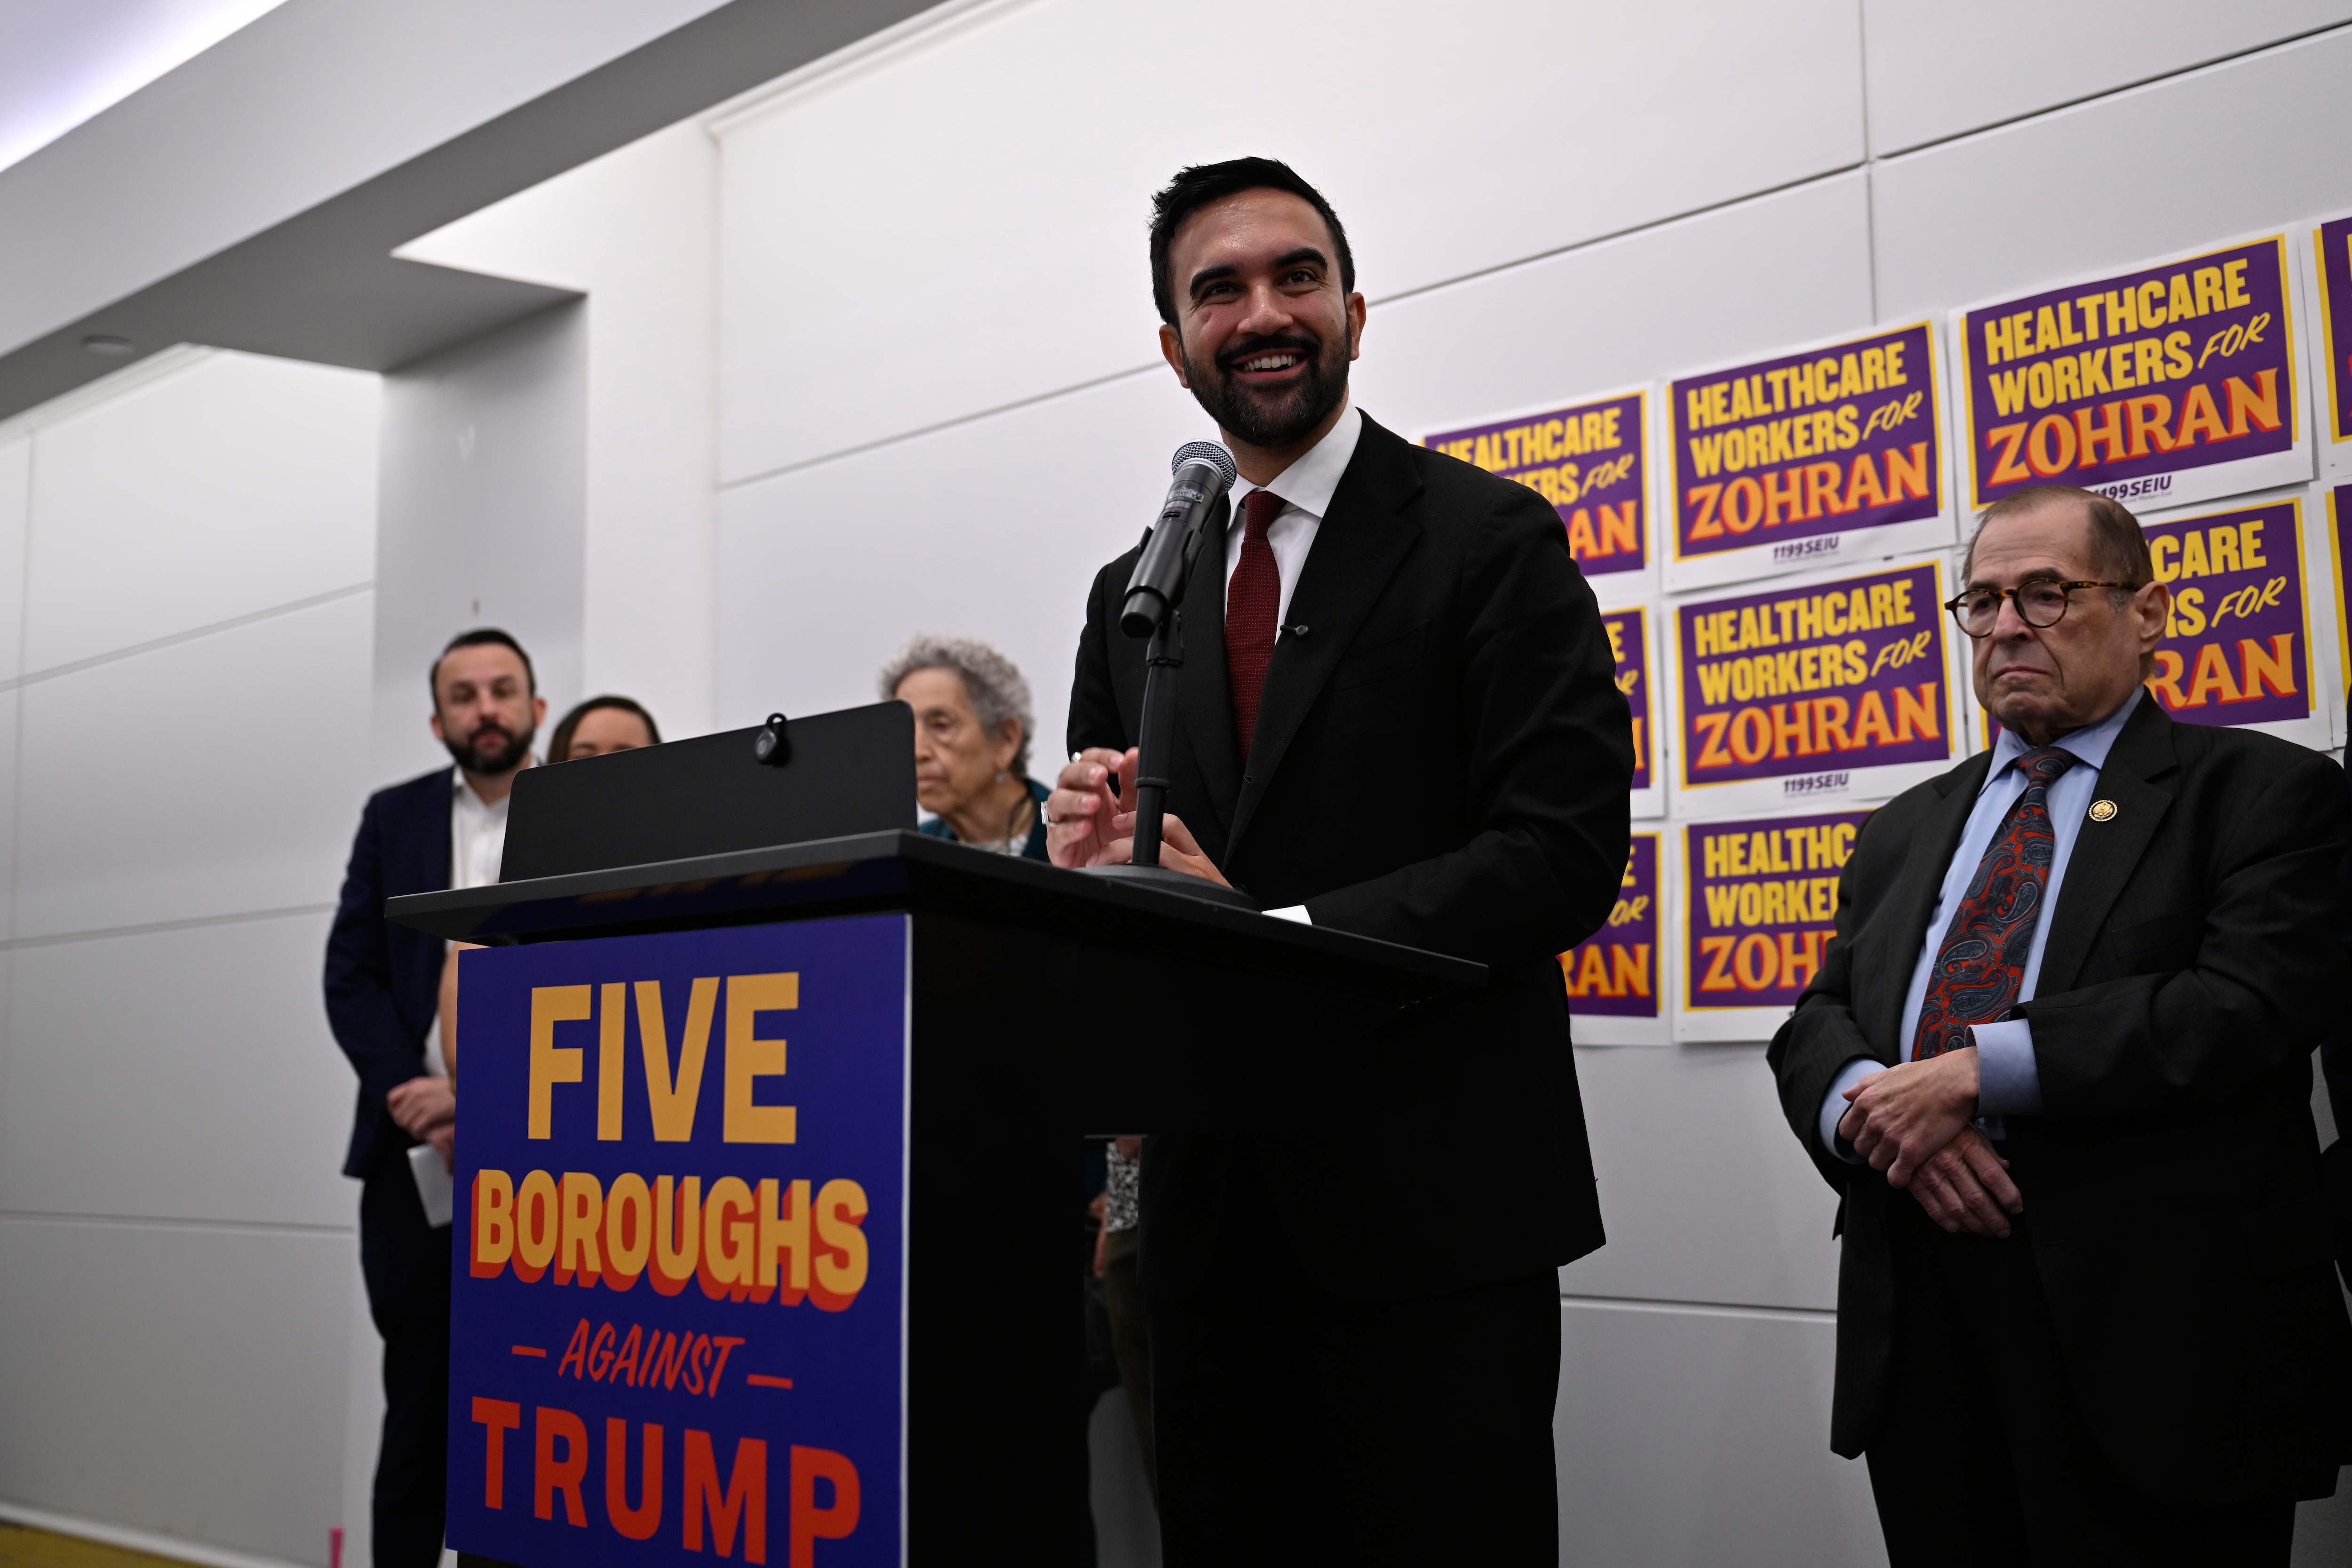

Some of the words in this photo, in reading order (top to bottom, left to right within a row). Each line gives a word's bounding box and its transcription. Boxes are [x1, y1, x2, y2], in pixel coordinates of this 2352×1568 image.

[1985, 258, 2250, 366] HEALTHCARE
[1687, 341, 1907, 430] HEALTHCARE
[1988, 330, 2193, 417] WORKERS
[2198, 312, 2270, 369] FOR
[1690, 404, 1859, 478] WORKERS
[1863, 390, 1923, 440] FOR
[1986, 367, 2283, 488] ZOHRAN
[1581, 453, 1635, 497] FOR
[1686, 441, 1929, 542] ZOHRAN
[2094, 476, 2171, 499] 199SEIU
[1774, 537, 1839, 557] 1199SEIU
[1695, 578, 1915, 657] HEALTHCARE
[2211, 576, 2287, 628] FOR
[1697, 640, 1868, 706] WORKERS
[1870, 630, 1931, 677] FOR
[1693, 682, 1940, 770] ZOHRAN
[1784, 772, 1849, 792] 1199SEIU
[1703, 822, 1857, 878] HEALTHC
[1705, 876, 1841, 928] WORKE
[528, 971, 800, 1144] FIVE
[470, 1169, 869, 1313] BOROUGHS
[558, 1317, 746, 1399] AGAINST
[472, 1396, 861, 1568] TRUMP
